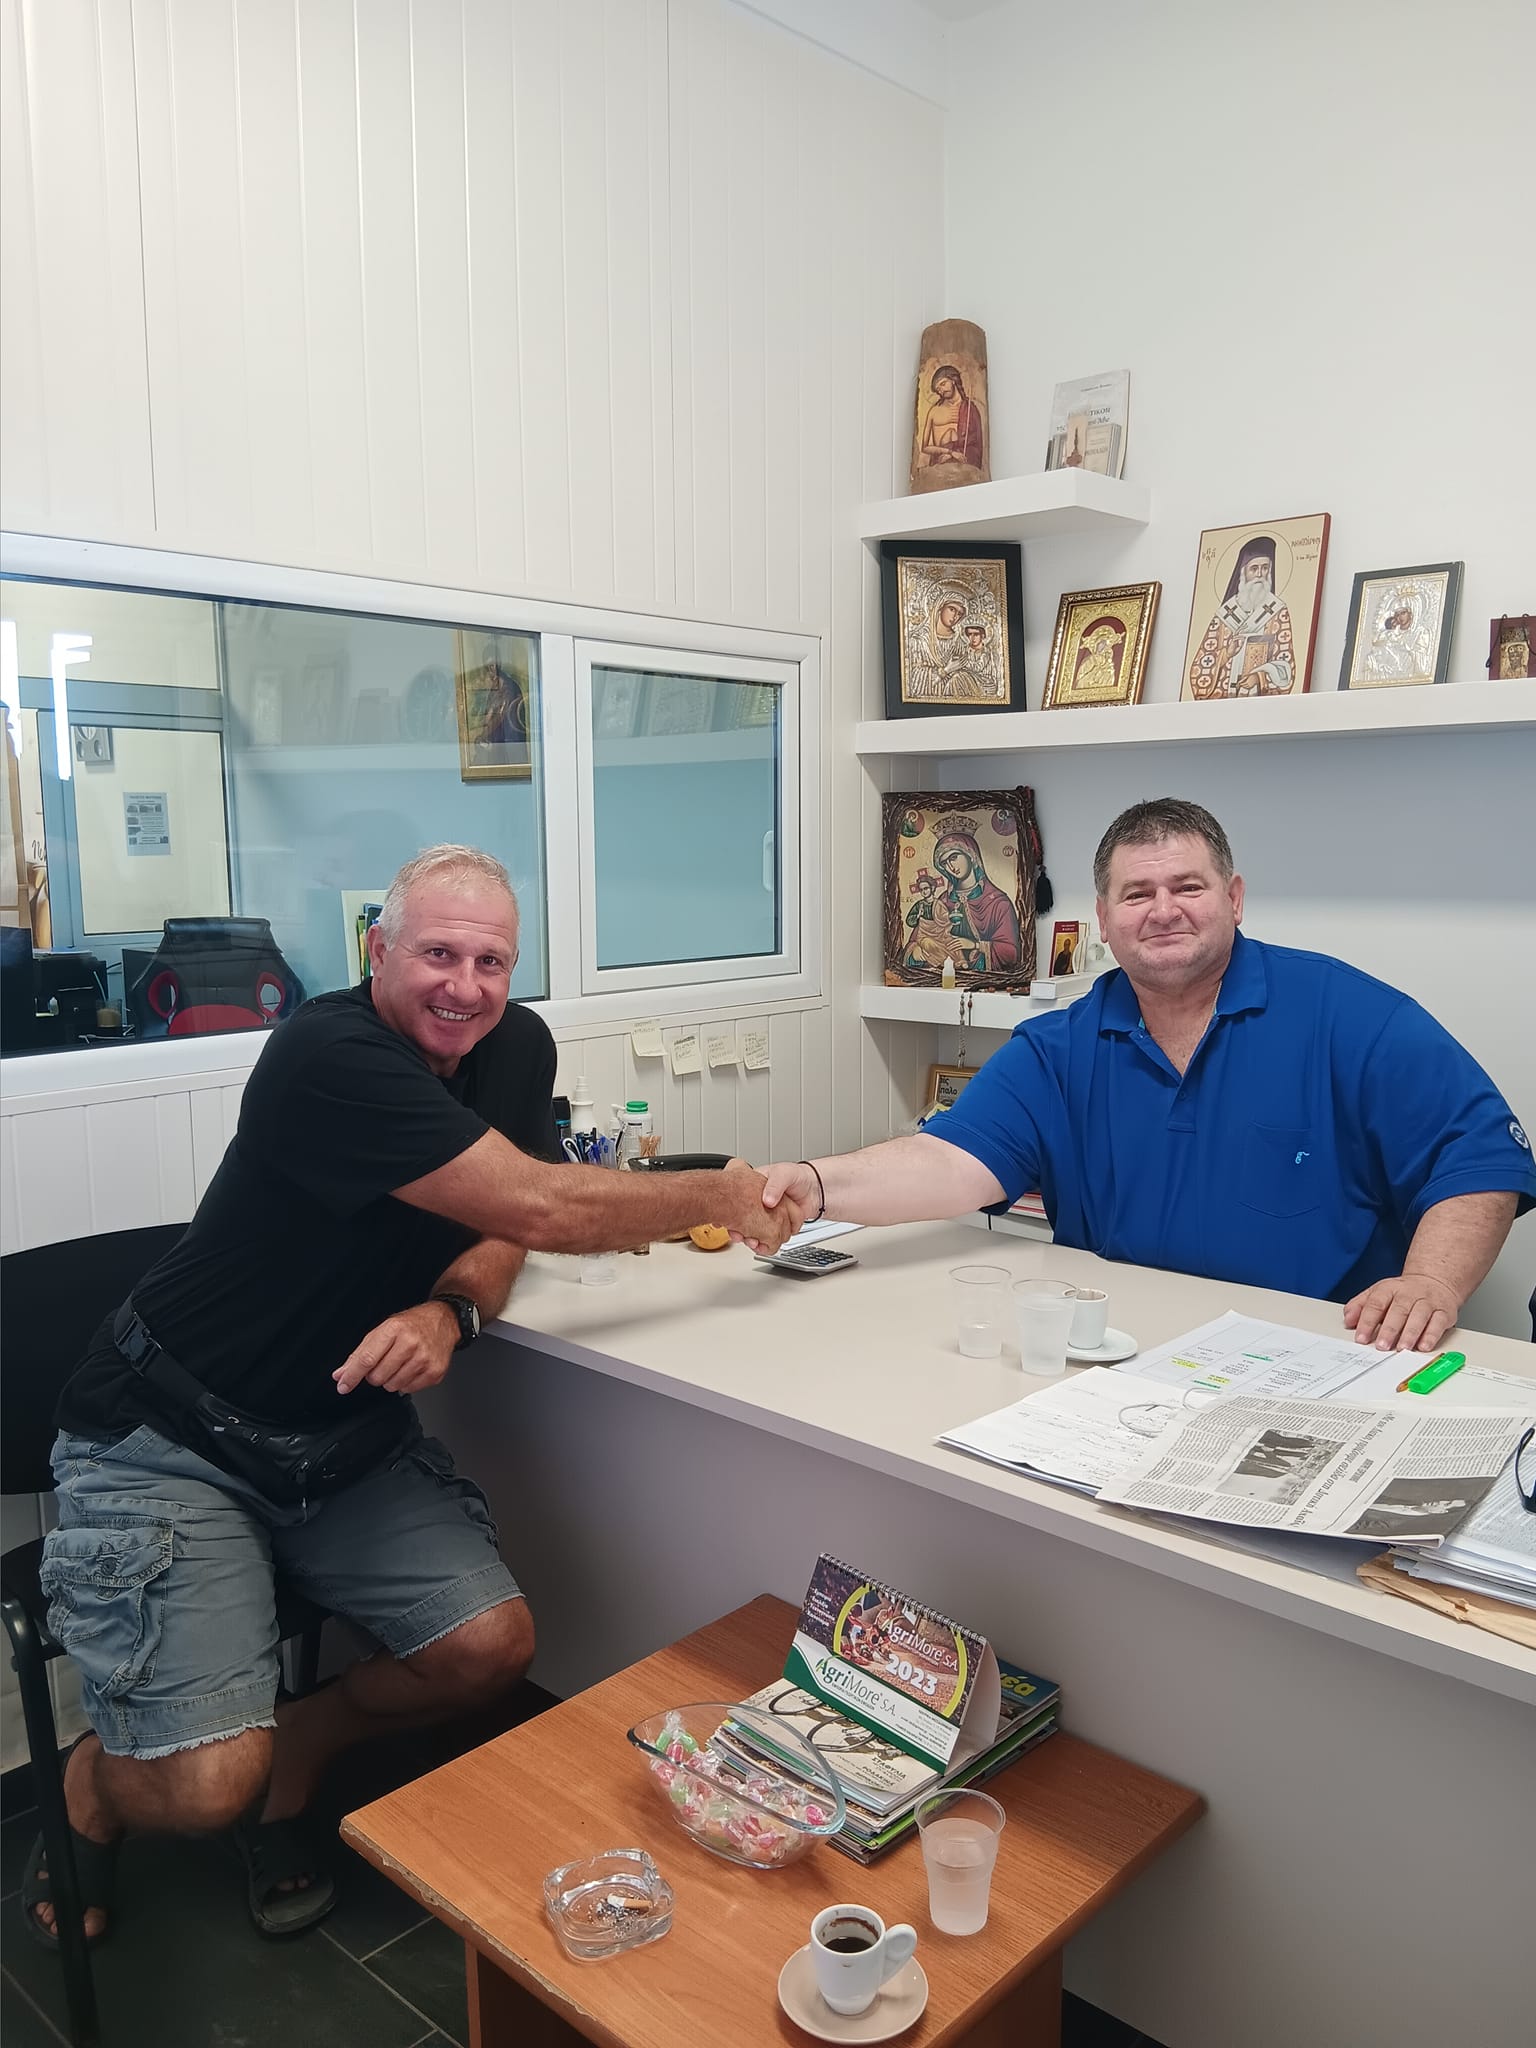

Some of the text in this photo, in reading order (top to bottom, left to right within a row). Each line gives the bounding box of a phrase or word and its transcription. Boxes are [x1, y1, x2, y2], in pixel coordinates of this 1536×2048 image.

[882, 1616, 943, 1660] AgriMore
[816, 1656, 881, 1706] AgriMore
[880, 1699, 896, 1716] S.A.
[885, 1653, 938, 1695] 2023
